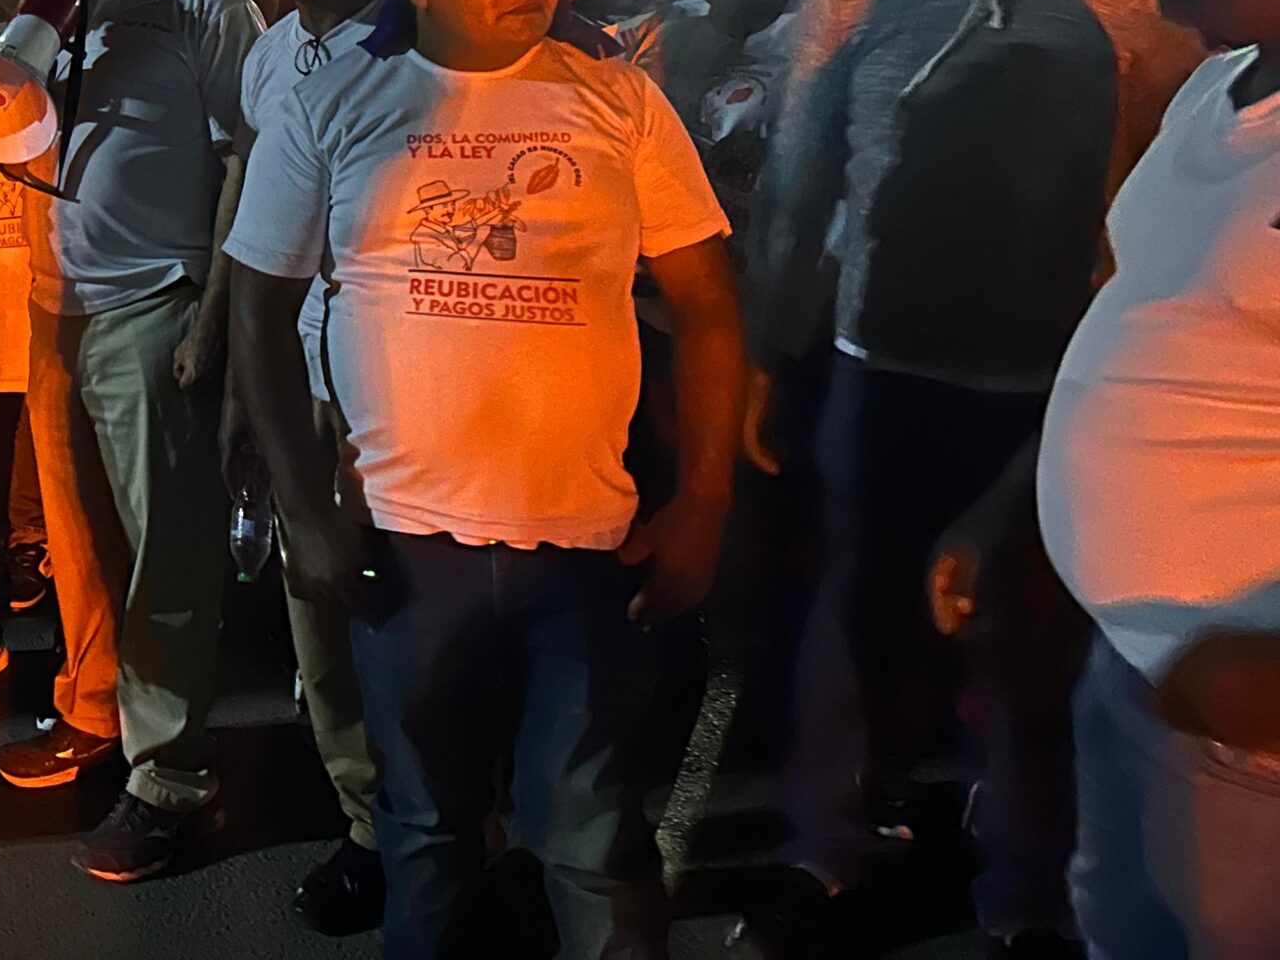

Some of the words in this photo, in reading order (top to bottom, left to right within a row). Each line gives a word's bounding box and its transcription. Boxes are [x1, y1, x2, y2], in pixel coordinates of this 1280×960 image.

[406, 134, 448, 146] DIOS,
[452, 134, 469, 144] LA
[474, 132, 572, 145] COMUNIDAD
[408, 145, 422, 159] Y
[427, 146, 453, 159] LA
[460, 145, 496, 159] LEY
[408, 278, 580, 305] REUBICACIÓN
[412, 297, 425, 311] Y
[428, 299, 496, 317] PAGOS
[501, 304, 577, 323] JUSTOS
